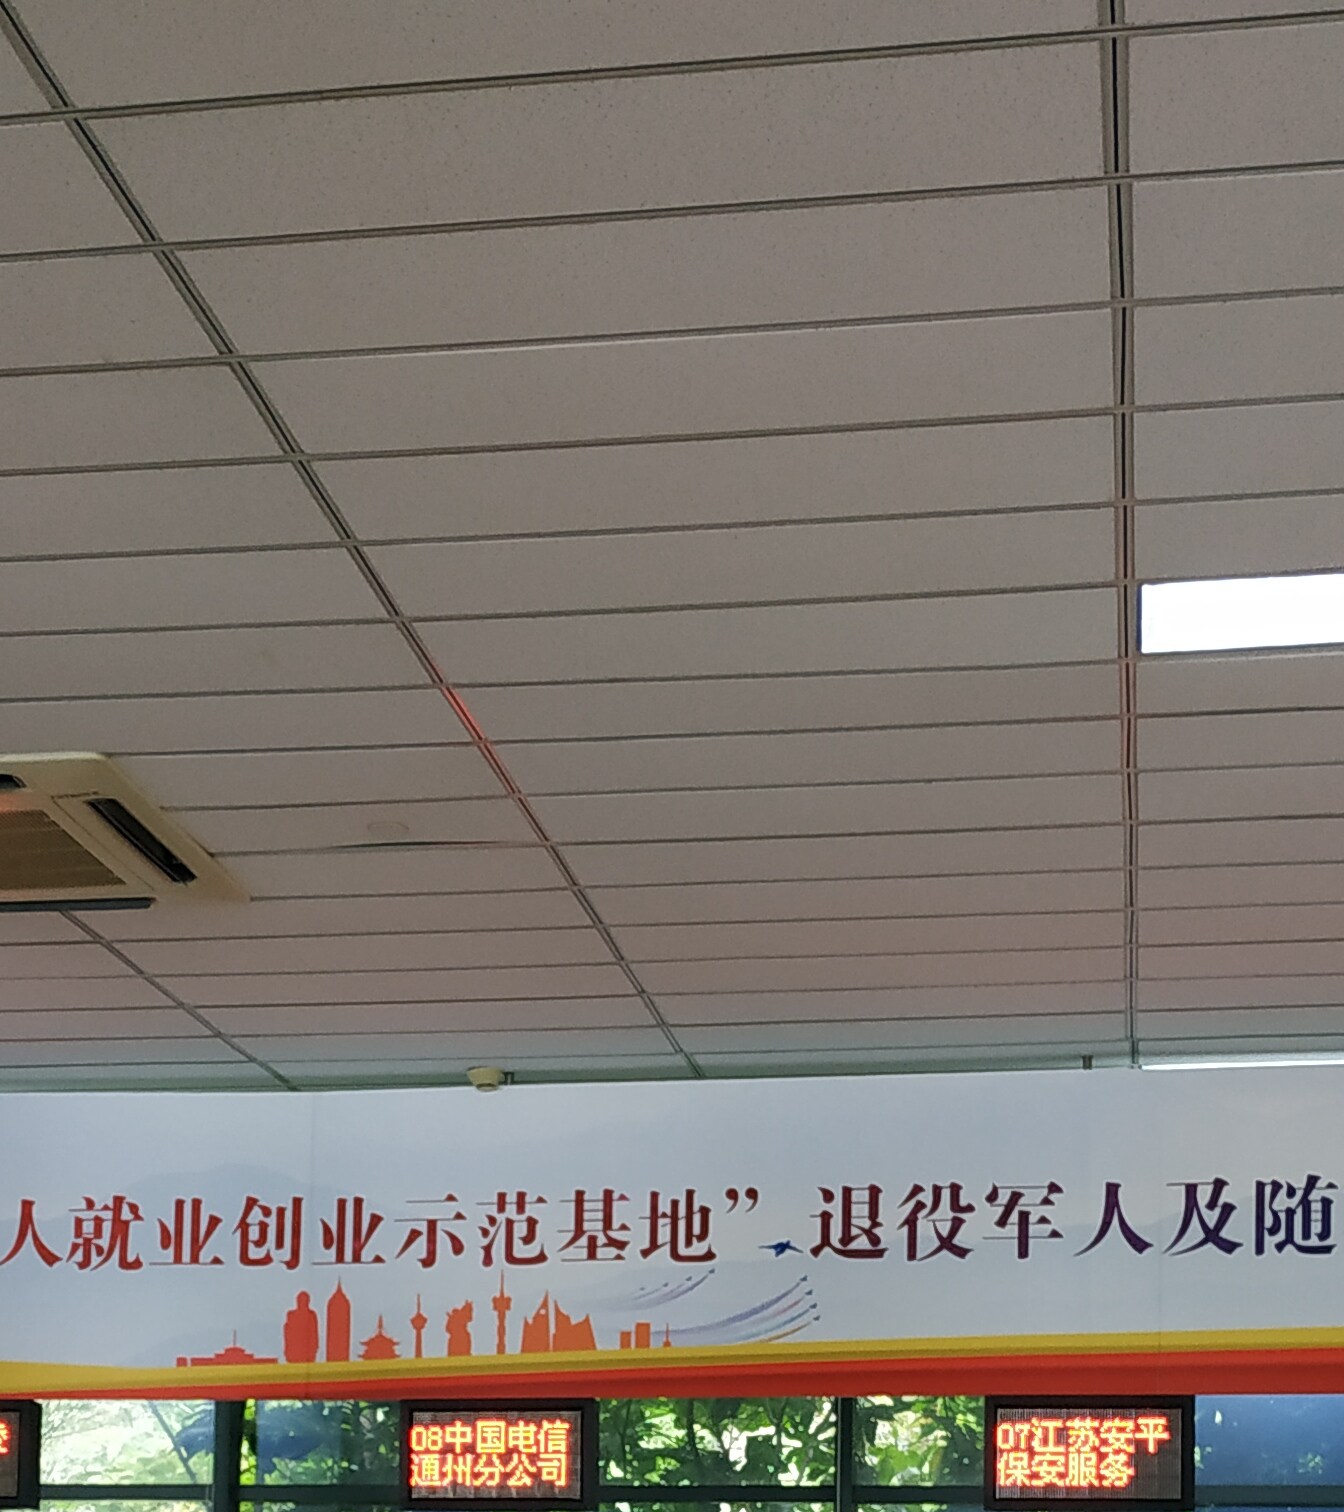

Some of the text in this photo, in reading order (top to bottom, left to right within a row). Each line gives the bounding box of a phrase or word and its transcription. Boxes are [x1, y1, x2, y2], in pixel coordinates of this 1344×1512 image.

[411, 1419, 570, 1454] 08中国电信
[997, 1416, 1170, 1454] 07江苏安平
[410, 1453, 568, 1487] 通州分公司
[997, 1451, 1136, 1487] 保安服务
